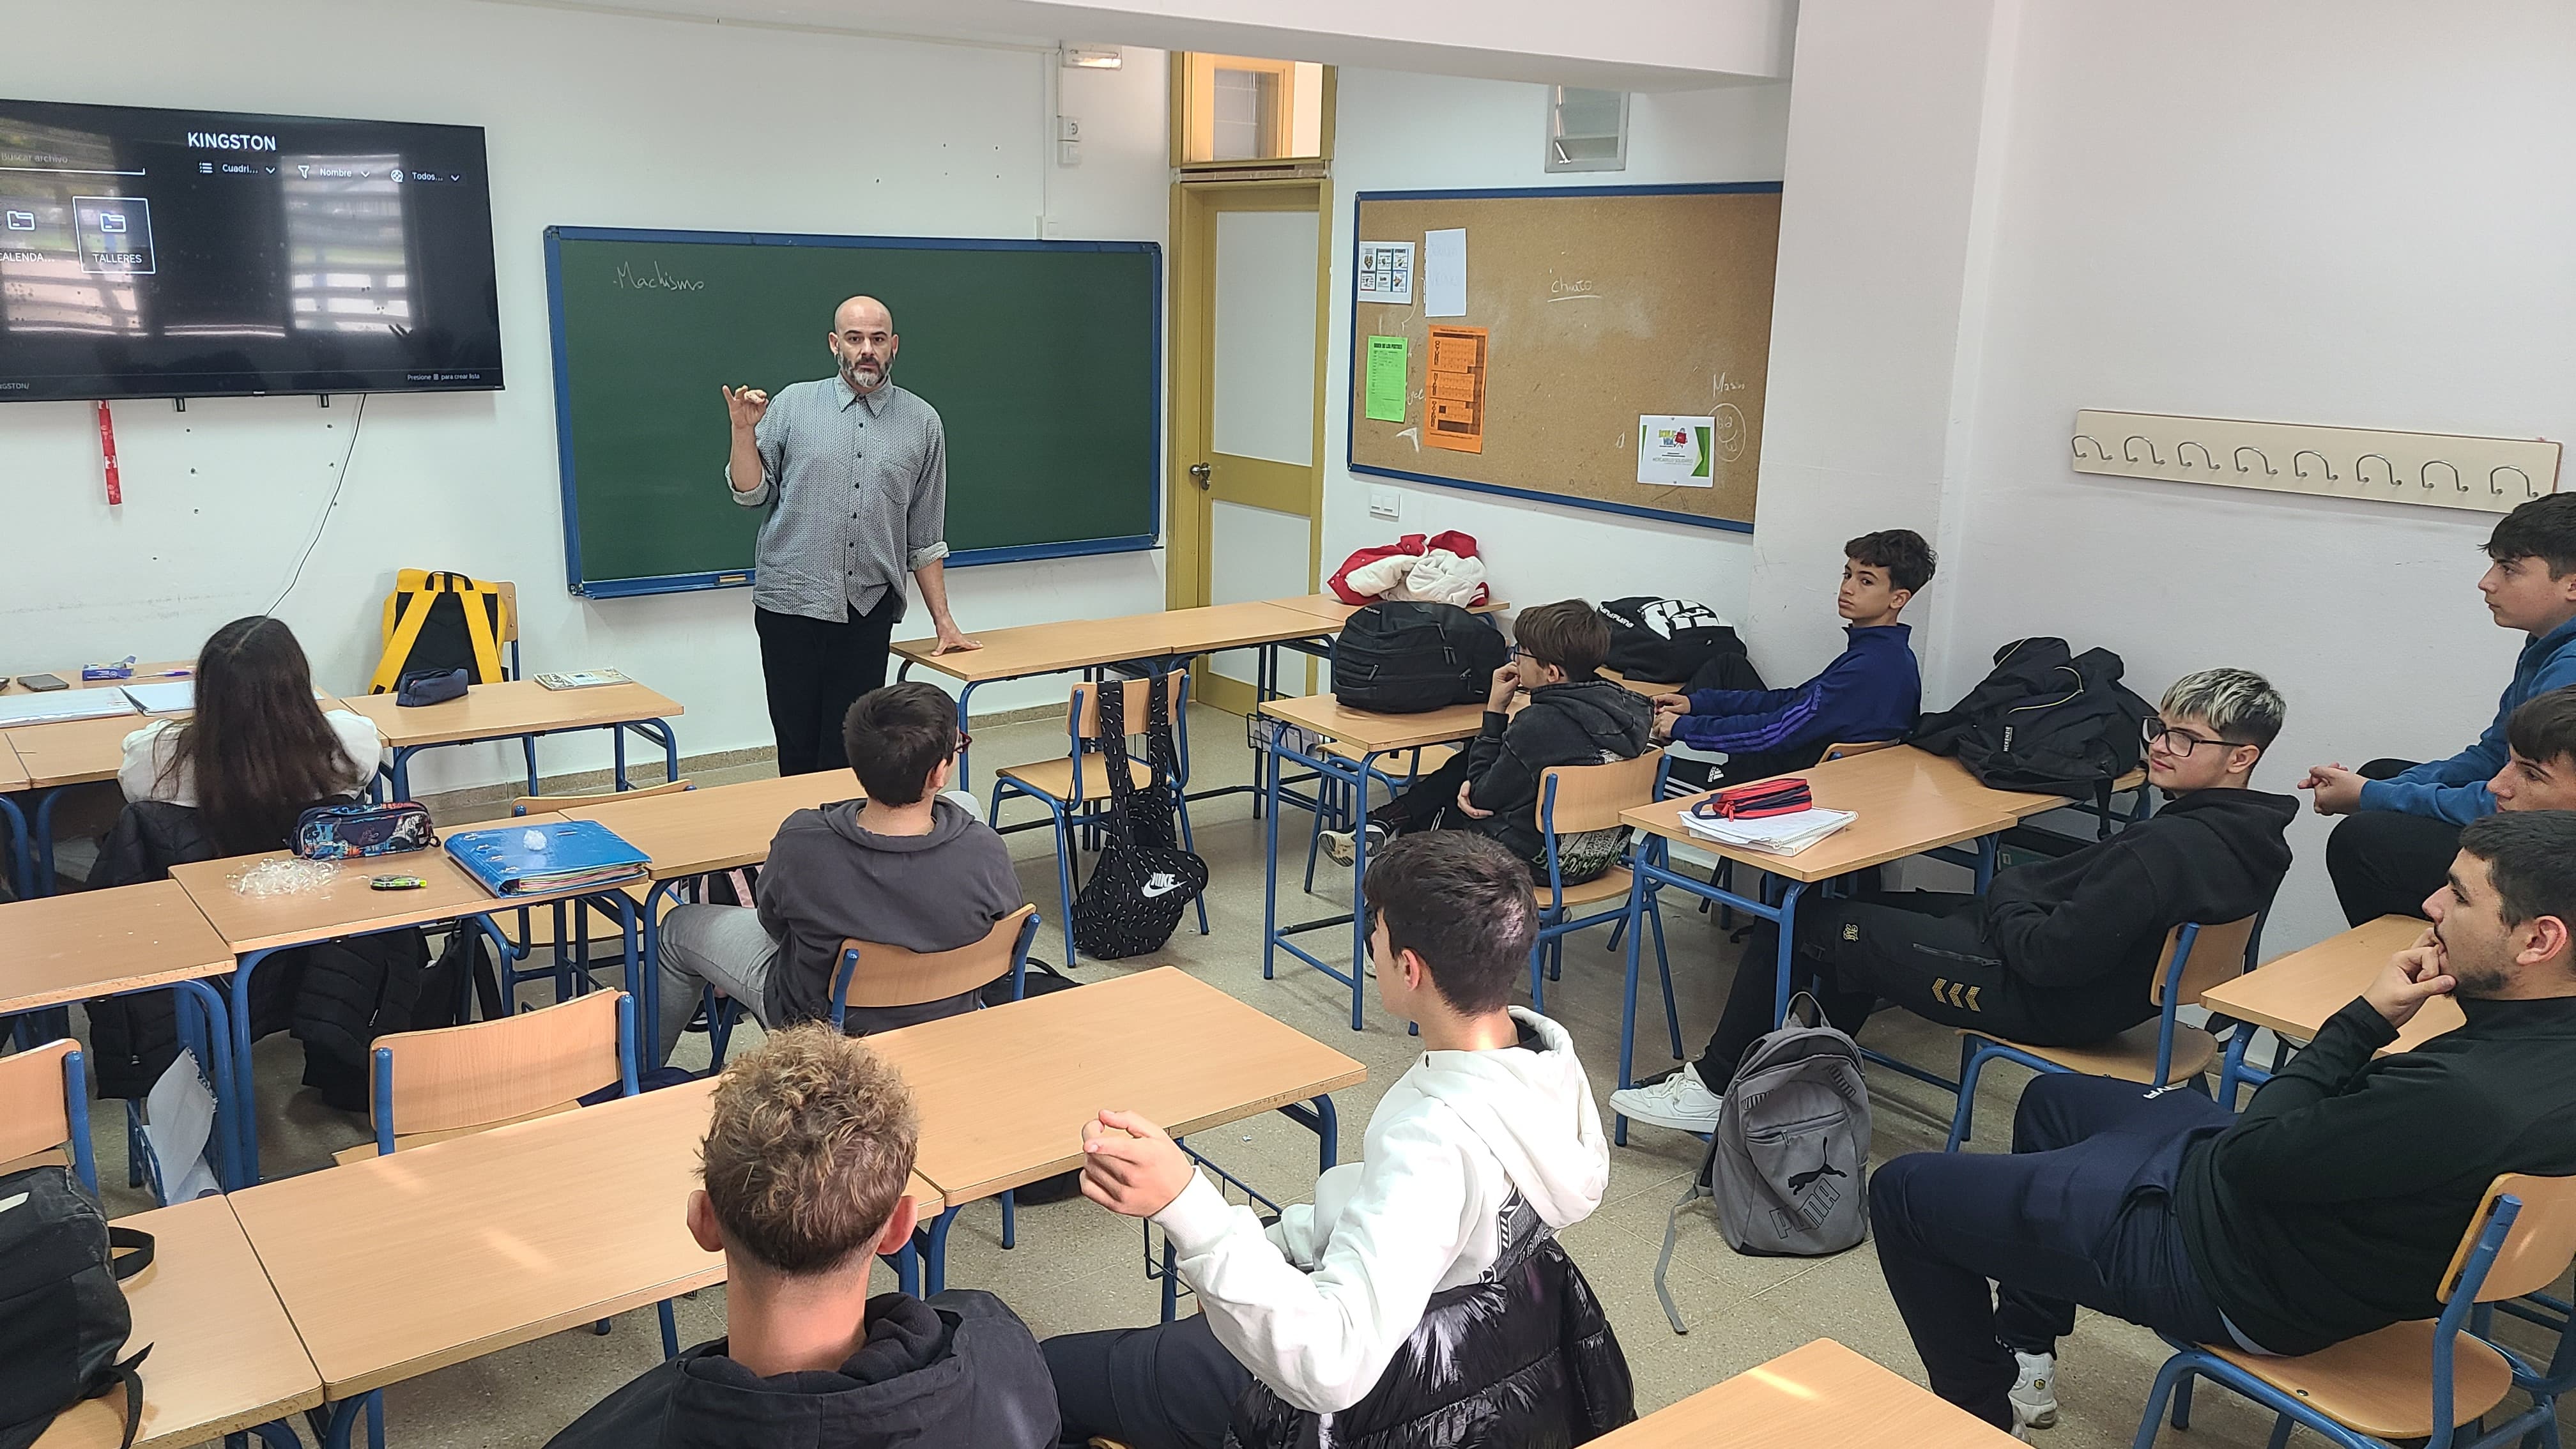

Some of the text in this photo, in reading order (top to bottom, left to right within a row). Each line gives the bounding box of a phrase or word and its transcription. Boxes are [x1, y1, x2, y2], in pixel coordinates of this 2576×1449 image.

[187, 132, 276, 151] KINGSTON
[34, 154, 68, 164] archivo
[319, 167, 351, 178] Nombre
[412, 171, 443, 181] Todos...
[92, 253, 142, 263] TALLERES
[1151, 871, 1176, 887] NIKE
[1769, 1177, 1841, 1240] PUMA
